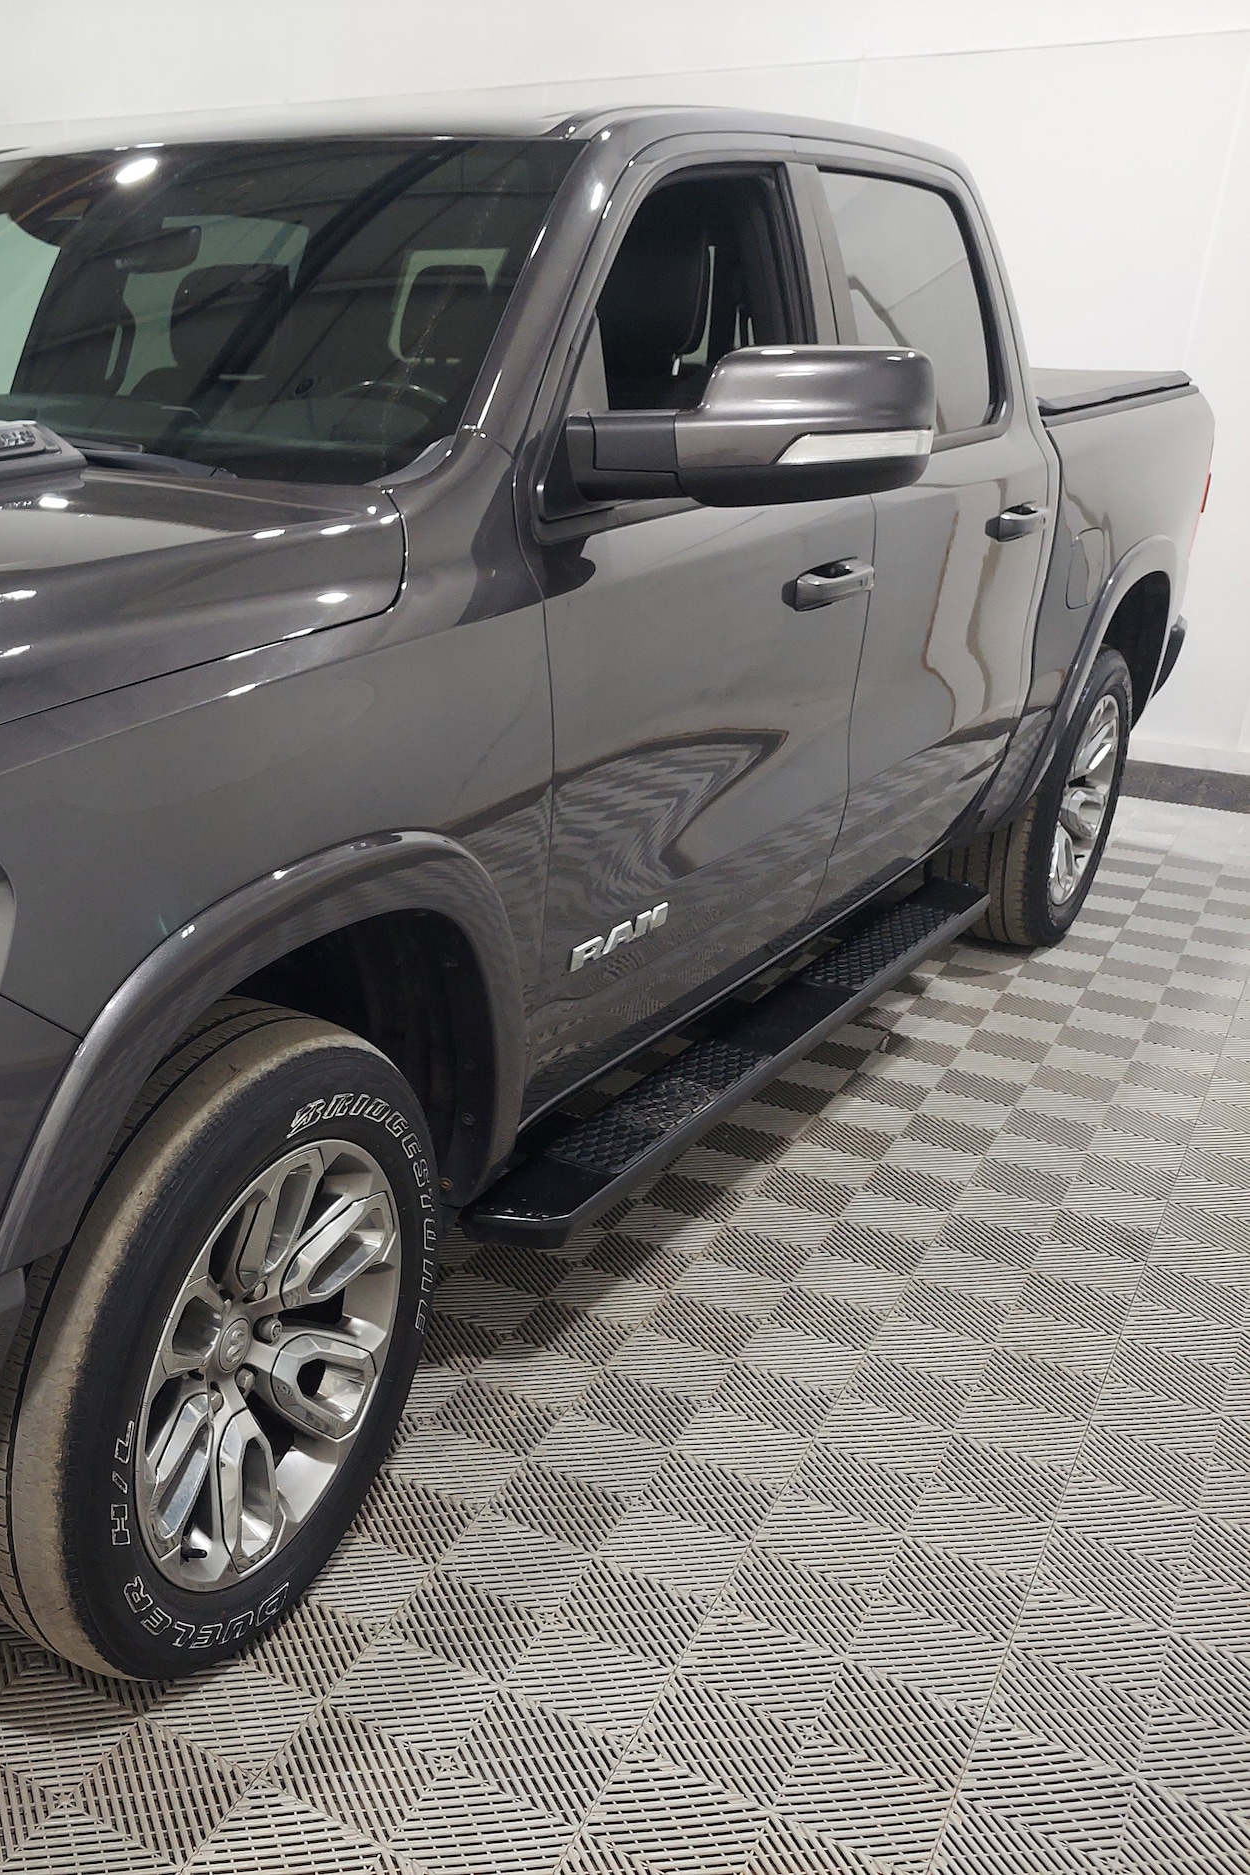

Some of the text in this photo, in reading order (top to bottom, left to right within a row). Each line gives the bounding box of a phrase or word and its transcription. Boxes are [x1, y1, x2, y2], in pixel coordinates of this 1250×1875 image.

[570, 901, 669, 973] RAM
[286, 1092, 436, 1337] BRIDGESTONE
[111, 1420, 290, 1650] DUELER H/L
